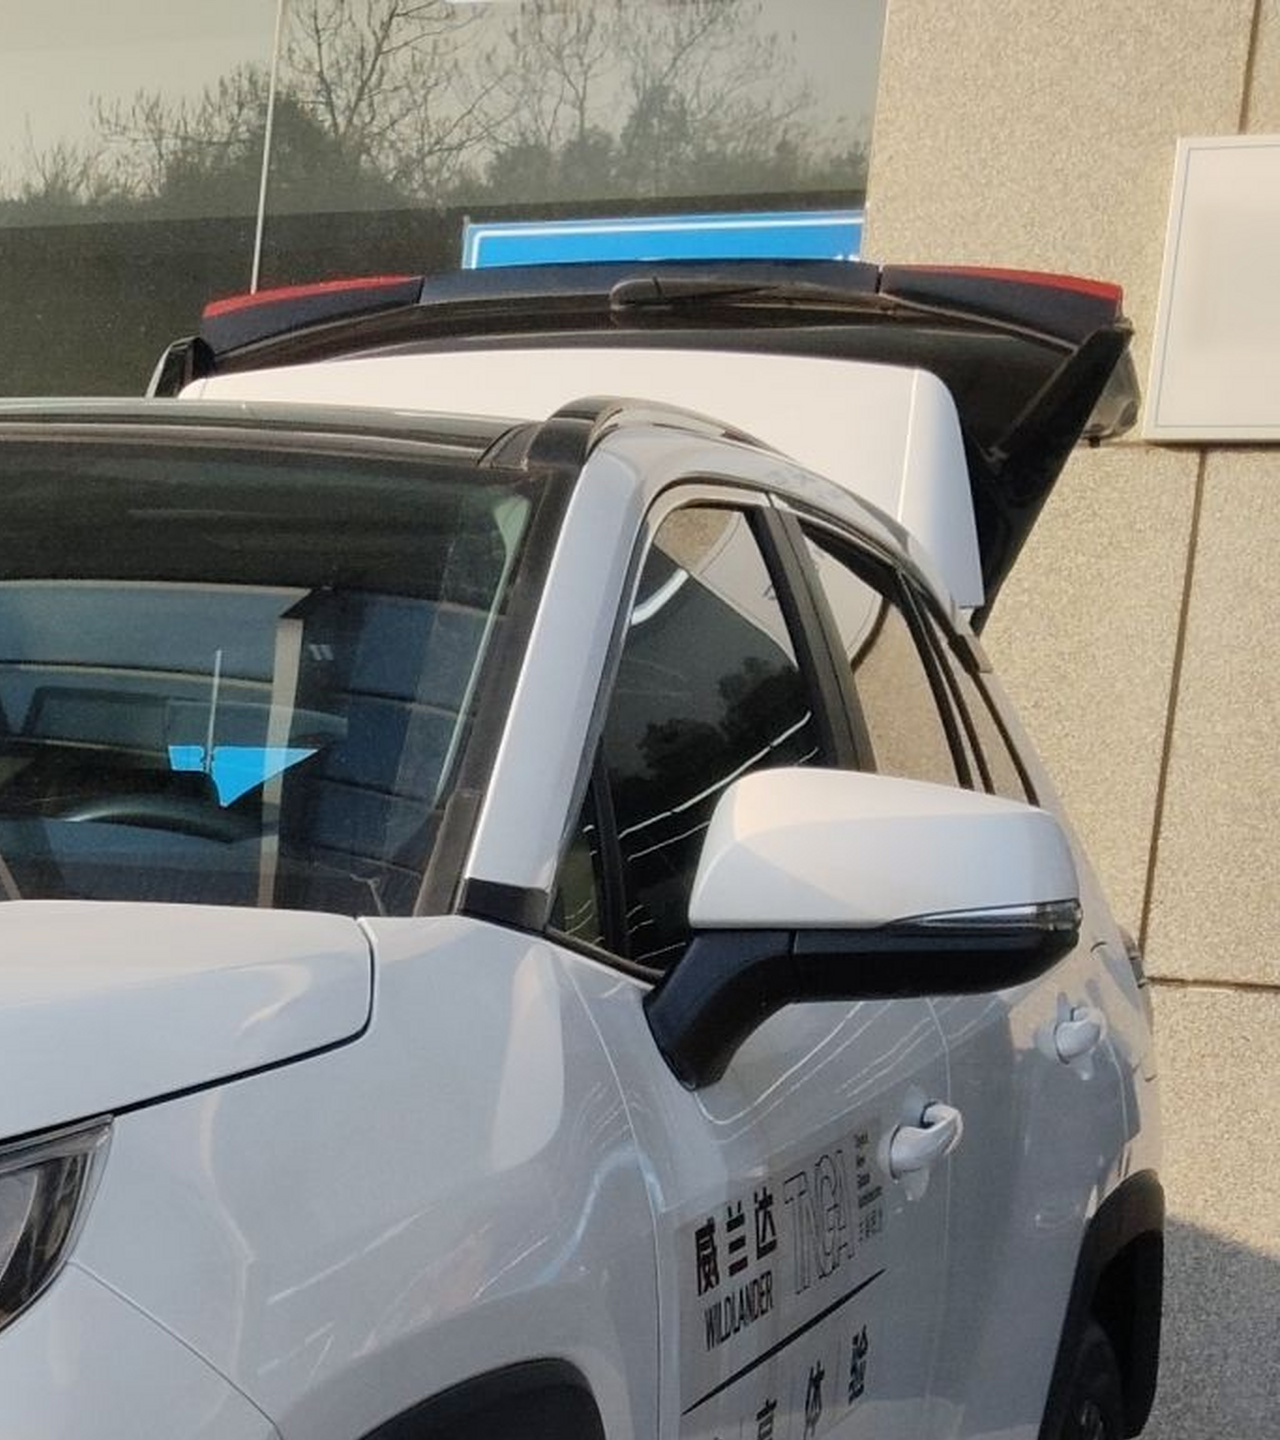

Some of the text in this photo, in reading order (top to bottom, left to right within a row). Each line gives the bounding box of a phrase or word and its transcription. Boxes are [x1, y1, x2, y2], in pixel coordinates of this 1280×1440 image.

[694, 1186, 778, 1298] 威兰达
[703, 1269, 775, 1352] WILDLANDER
